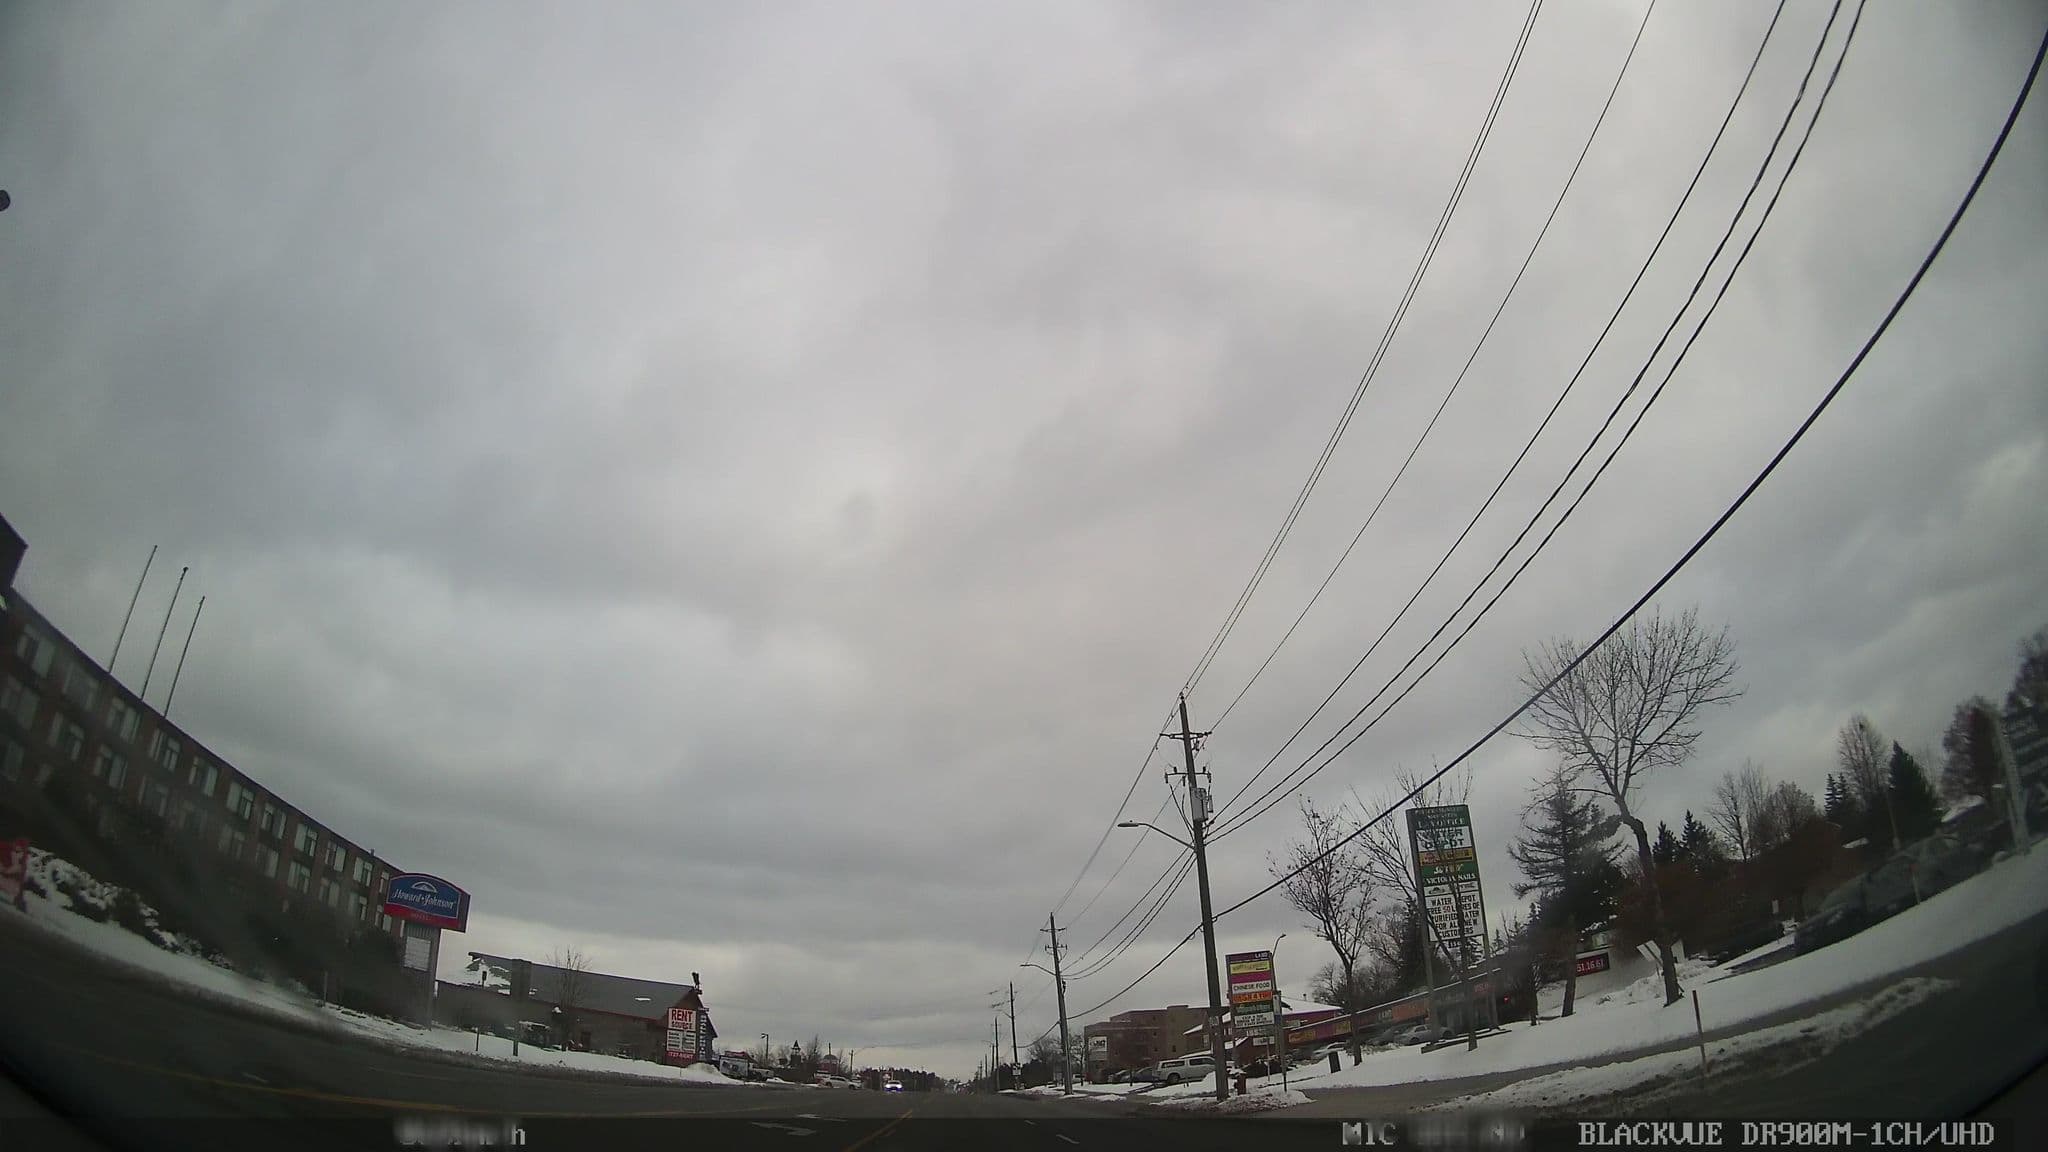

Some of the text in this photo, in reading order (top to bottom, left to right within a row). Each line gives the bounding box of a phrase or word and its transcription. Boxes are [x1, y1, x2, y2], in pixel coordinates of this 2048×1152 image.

[392, 889, 454, 910] Howard Johnson
[1431, 897, 1452, 906] WATER
[671, 1009, 693, 1023] RENT
